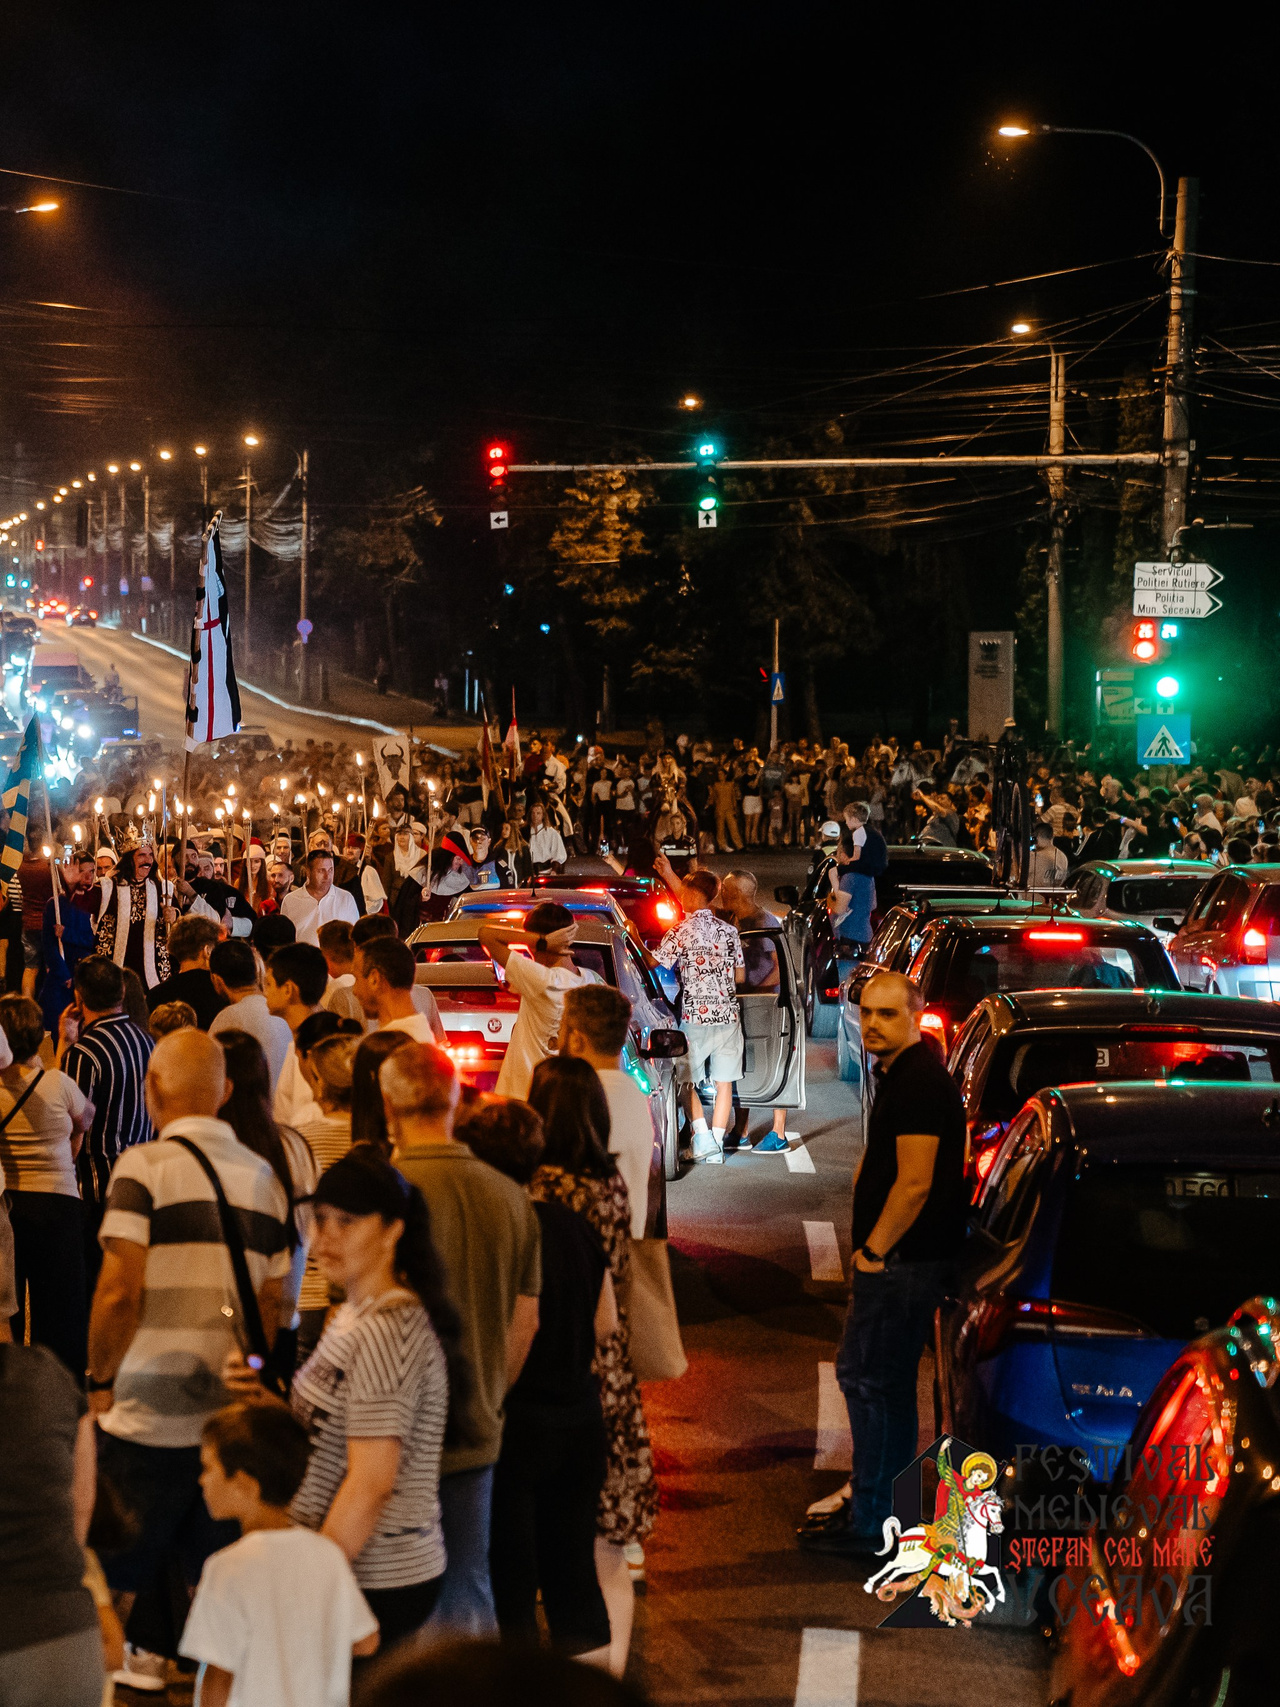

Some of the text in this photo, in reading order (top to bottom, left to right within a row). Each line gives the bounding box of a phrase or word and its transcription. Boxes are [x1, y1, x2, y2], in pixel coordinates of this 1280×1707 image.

[1152, 565, 1192, 577] Serviciul
[1172, 577, 1205, 589] Rutiere
[1137, 604, 1202, 616] Mun. Suceava
